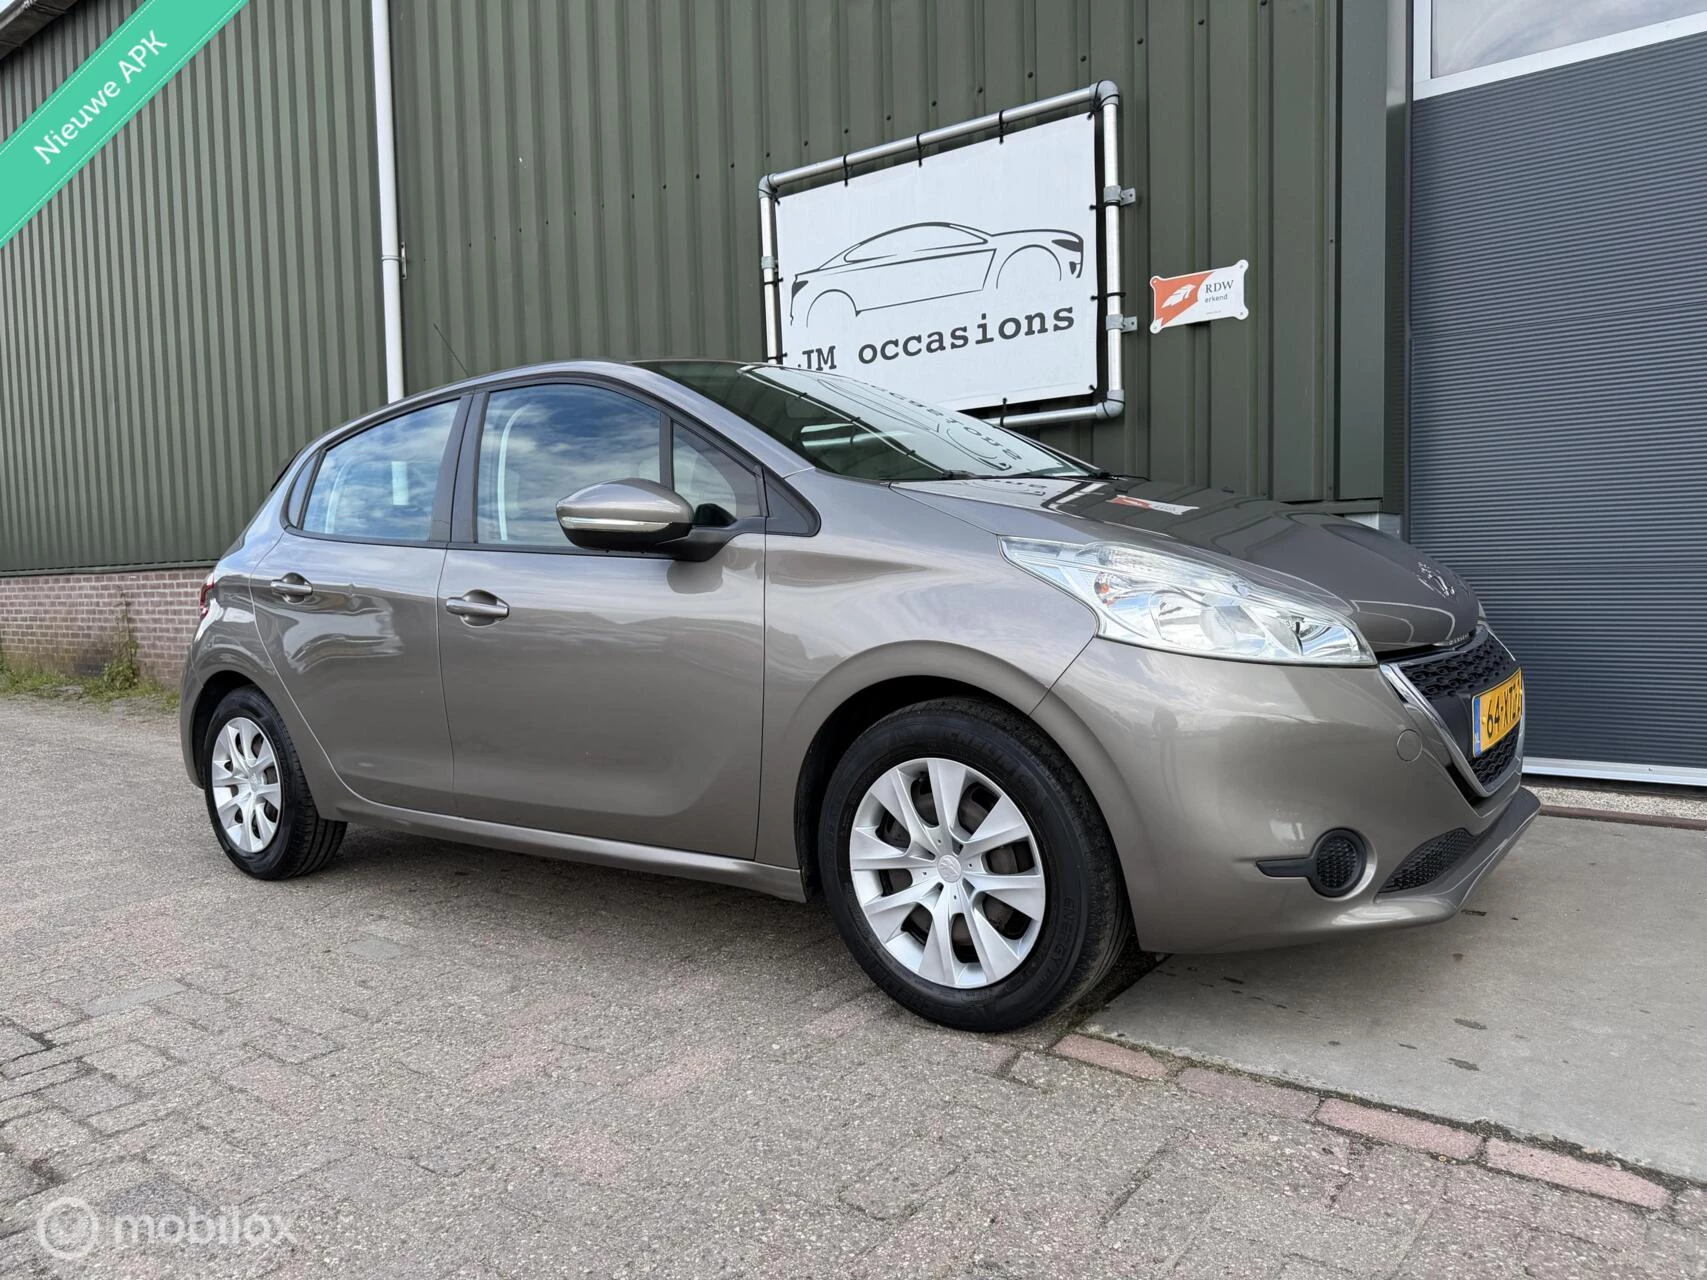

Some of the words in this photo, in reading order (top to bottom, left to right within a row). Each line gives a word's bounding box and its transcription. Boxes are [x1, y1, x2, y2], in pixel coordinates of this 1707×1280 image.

[1205, 280, 1234, 294] RDW
[1204, 294, 1228, 303] erkend
[857, 306, 1075, 365] occasions
